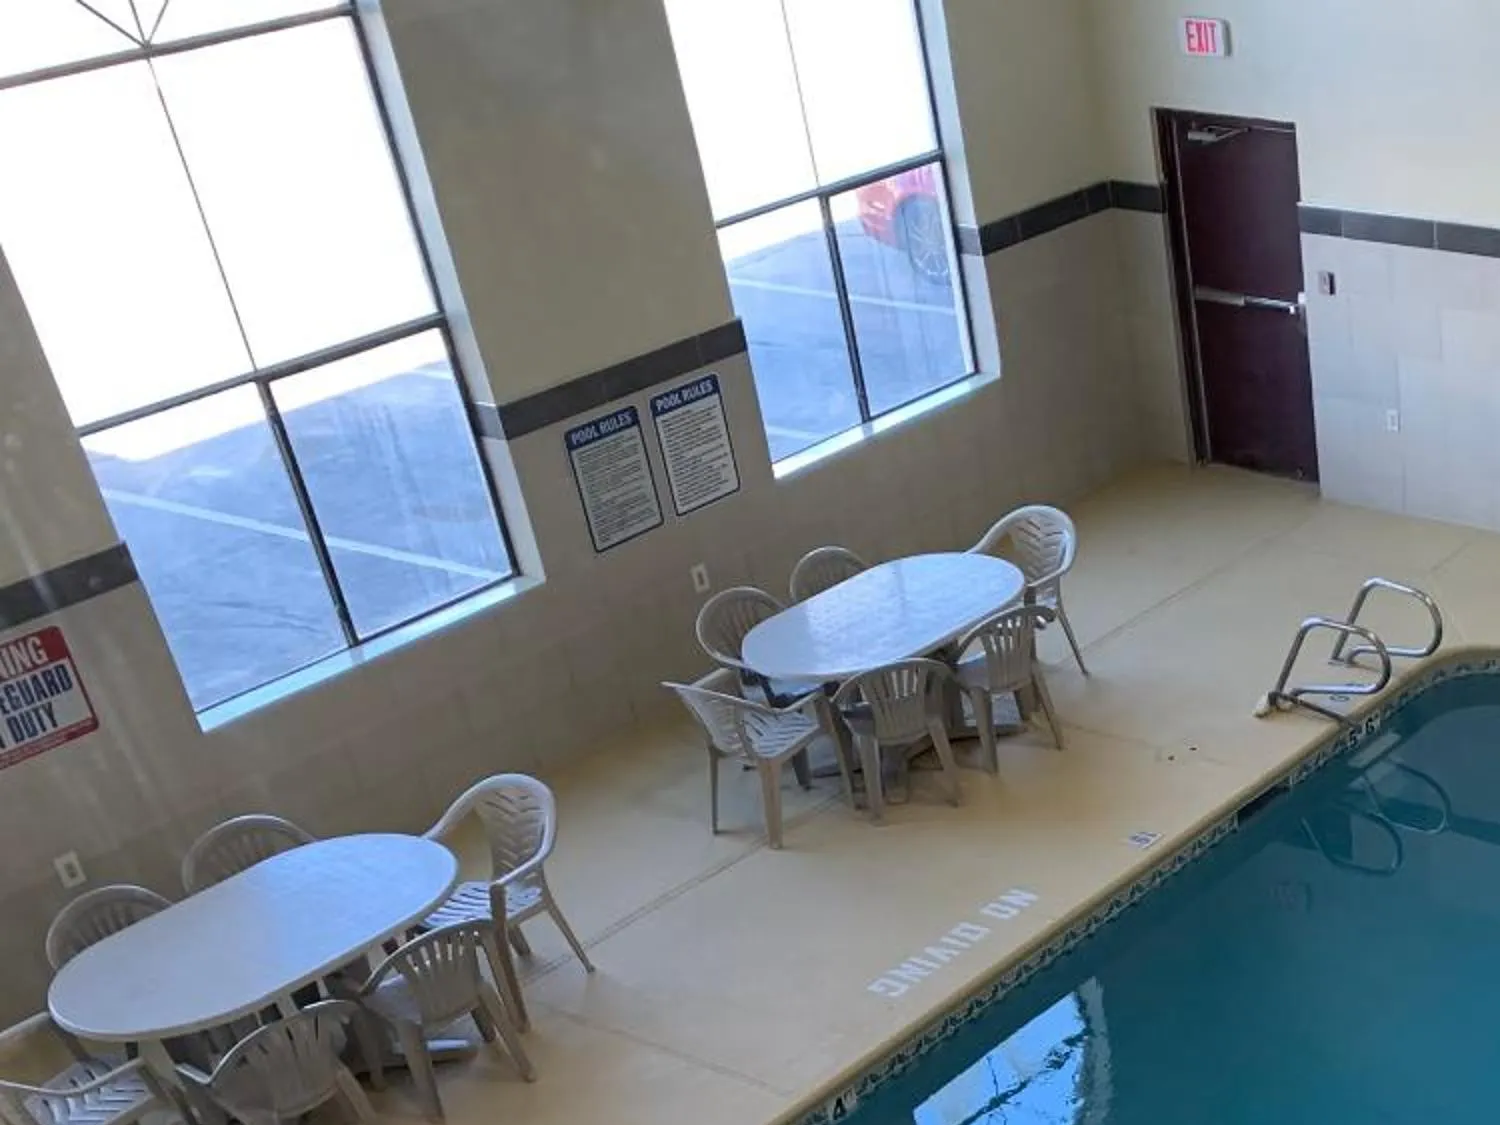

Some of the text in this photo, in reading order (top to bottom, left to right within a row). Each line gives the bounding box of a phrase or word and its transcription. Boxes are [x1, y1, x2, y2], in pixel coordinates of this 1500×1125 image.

[1185, 20, 1217, 53] EXIT
[656, 379, 714, 412] POOL RULES
[570, 410, 633, 446] POOL RULES
[5, 701, 58, 744] DUTY
[866, 889, 1038, 997] NO DIVING
